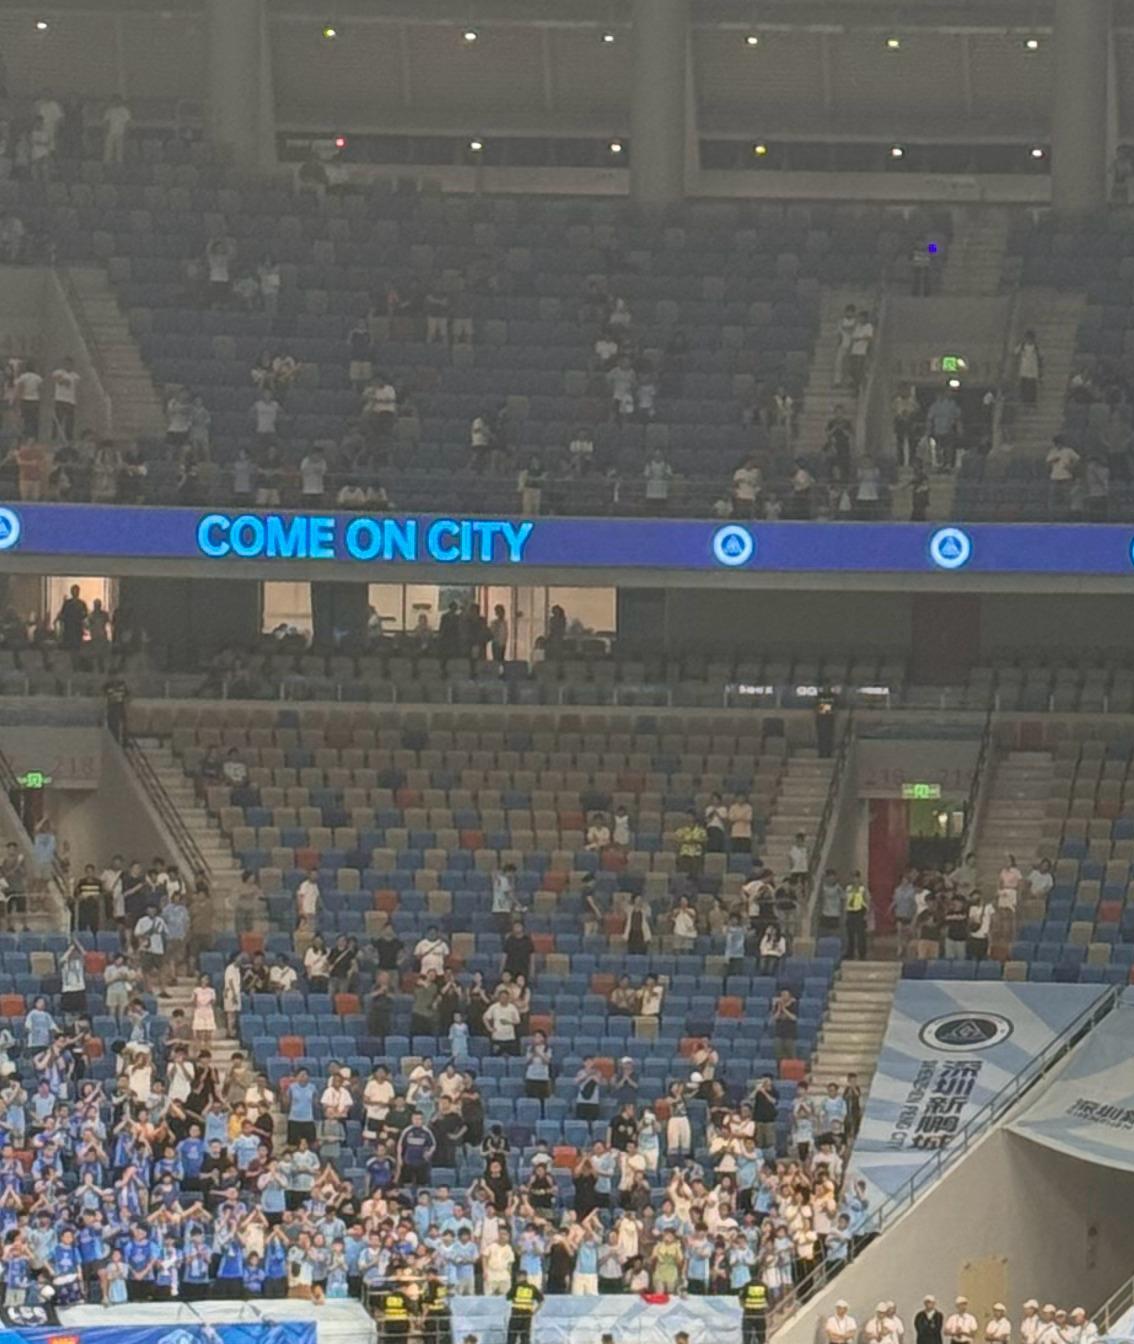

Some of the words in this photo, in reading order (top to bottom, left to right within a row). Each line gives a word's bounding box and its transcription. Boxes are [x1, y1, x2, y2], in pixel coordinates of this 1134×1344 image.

[198, 513, 335, 559] COME
[345, 518, 415, 560] ON
[427, 519, 533, 562] CITY
[911, 1060, 984, 1151] 深圳新鹏城
